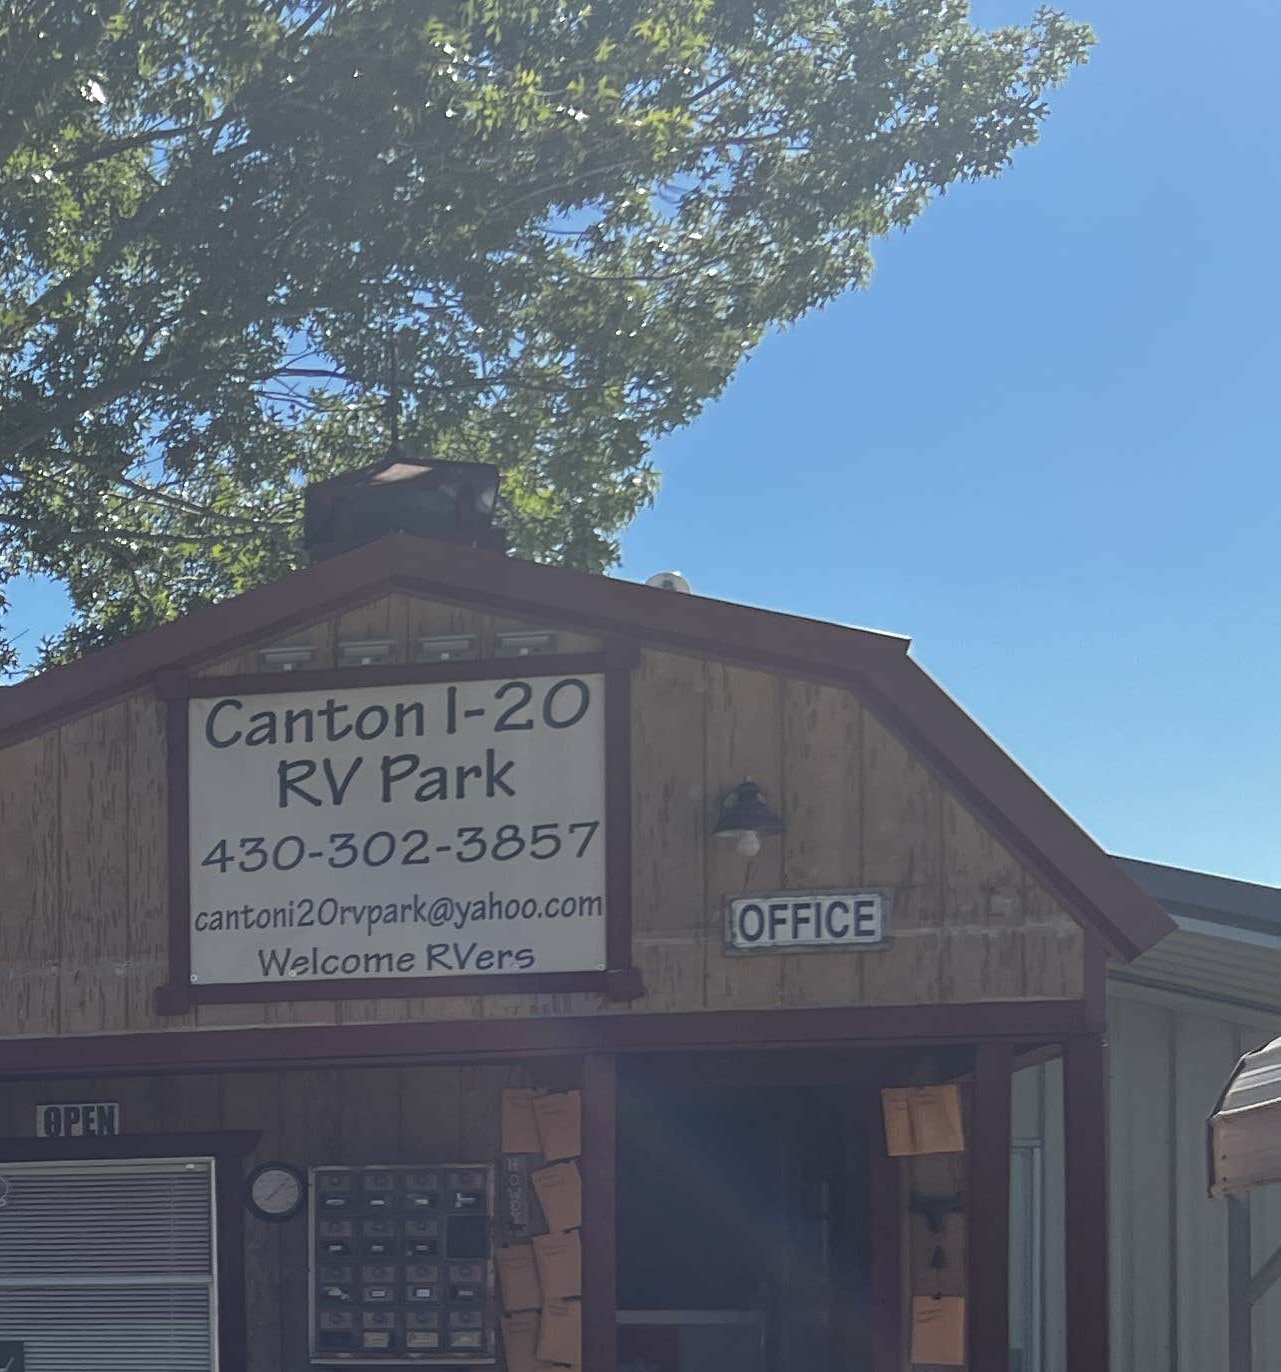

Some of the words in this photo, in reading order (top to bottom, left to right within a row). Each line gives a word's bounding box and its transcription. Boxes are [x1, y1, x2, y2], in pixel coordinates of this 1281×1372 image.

[205, 698, 424, 749] Canton
[446, 678, 591, 735] I-20
[278, 756, 363, 807] RV
[381, 748, 516, 802] Park
[201, 820, 600, 873] 430-302-3857
[195, 892, 603, 935] cantoni20rvpark@yahoo.com
[739, 900, 876, 941] OFFICE
[258, 947, 415, 976] Welcome
[426, 942, 535, 971] RVers
[44, 1105, 115, 1136] OPEN
